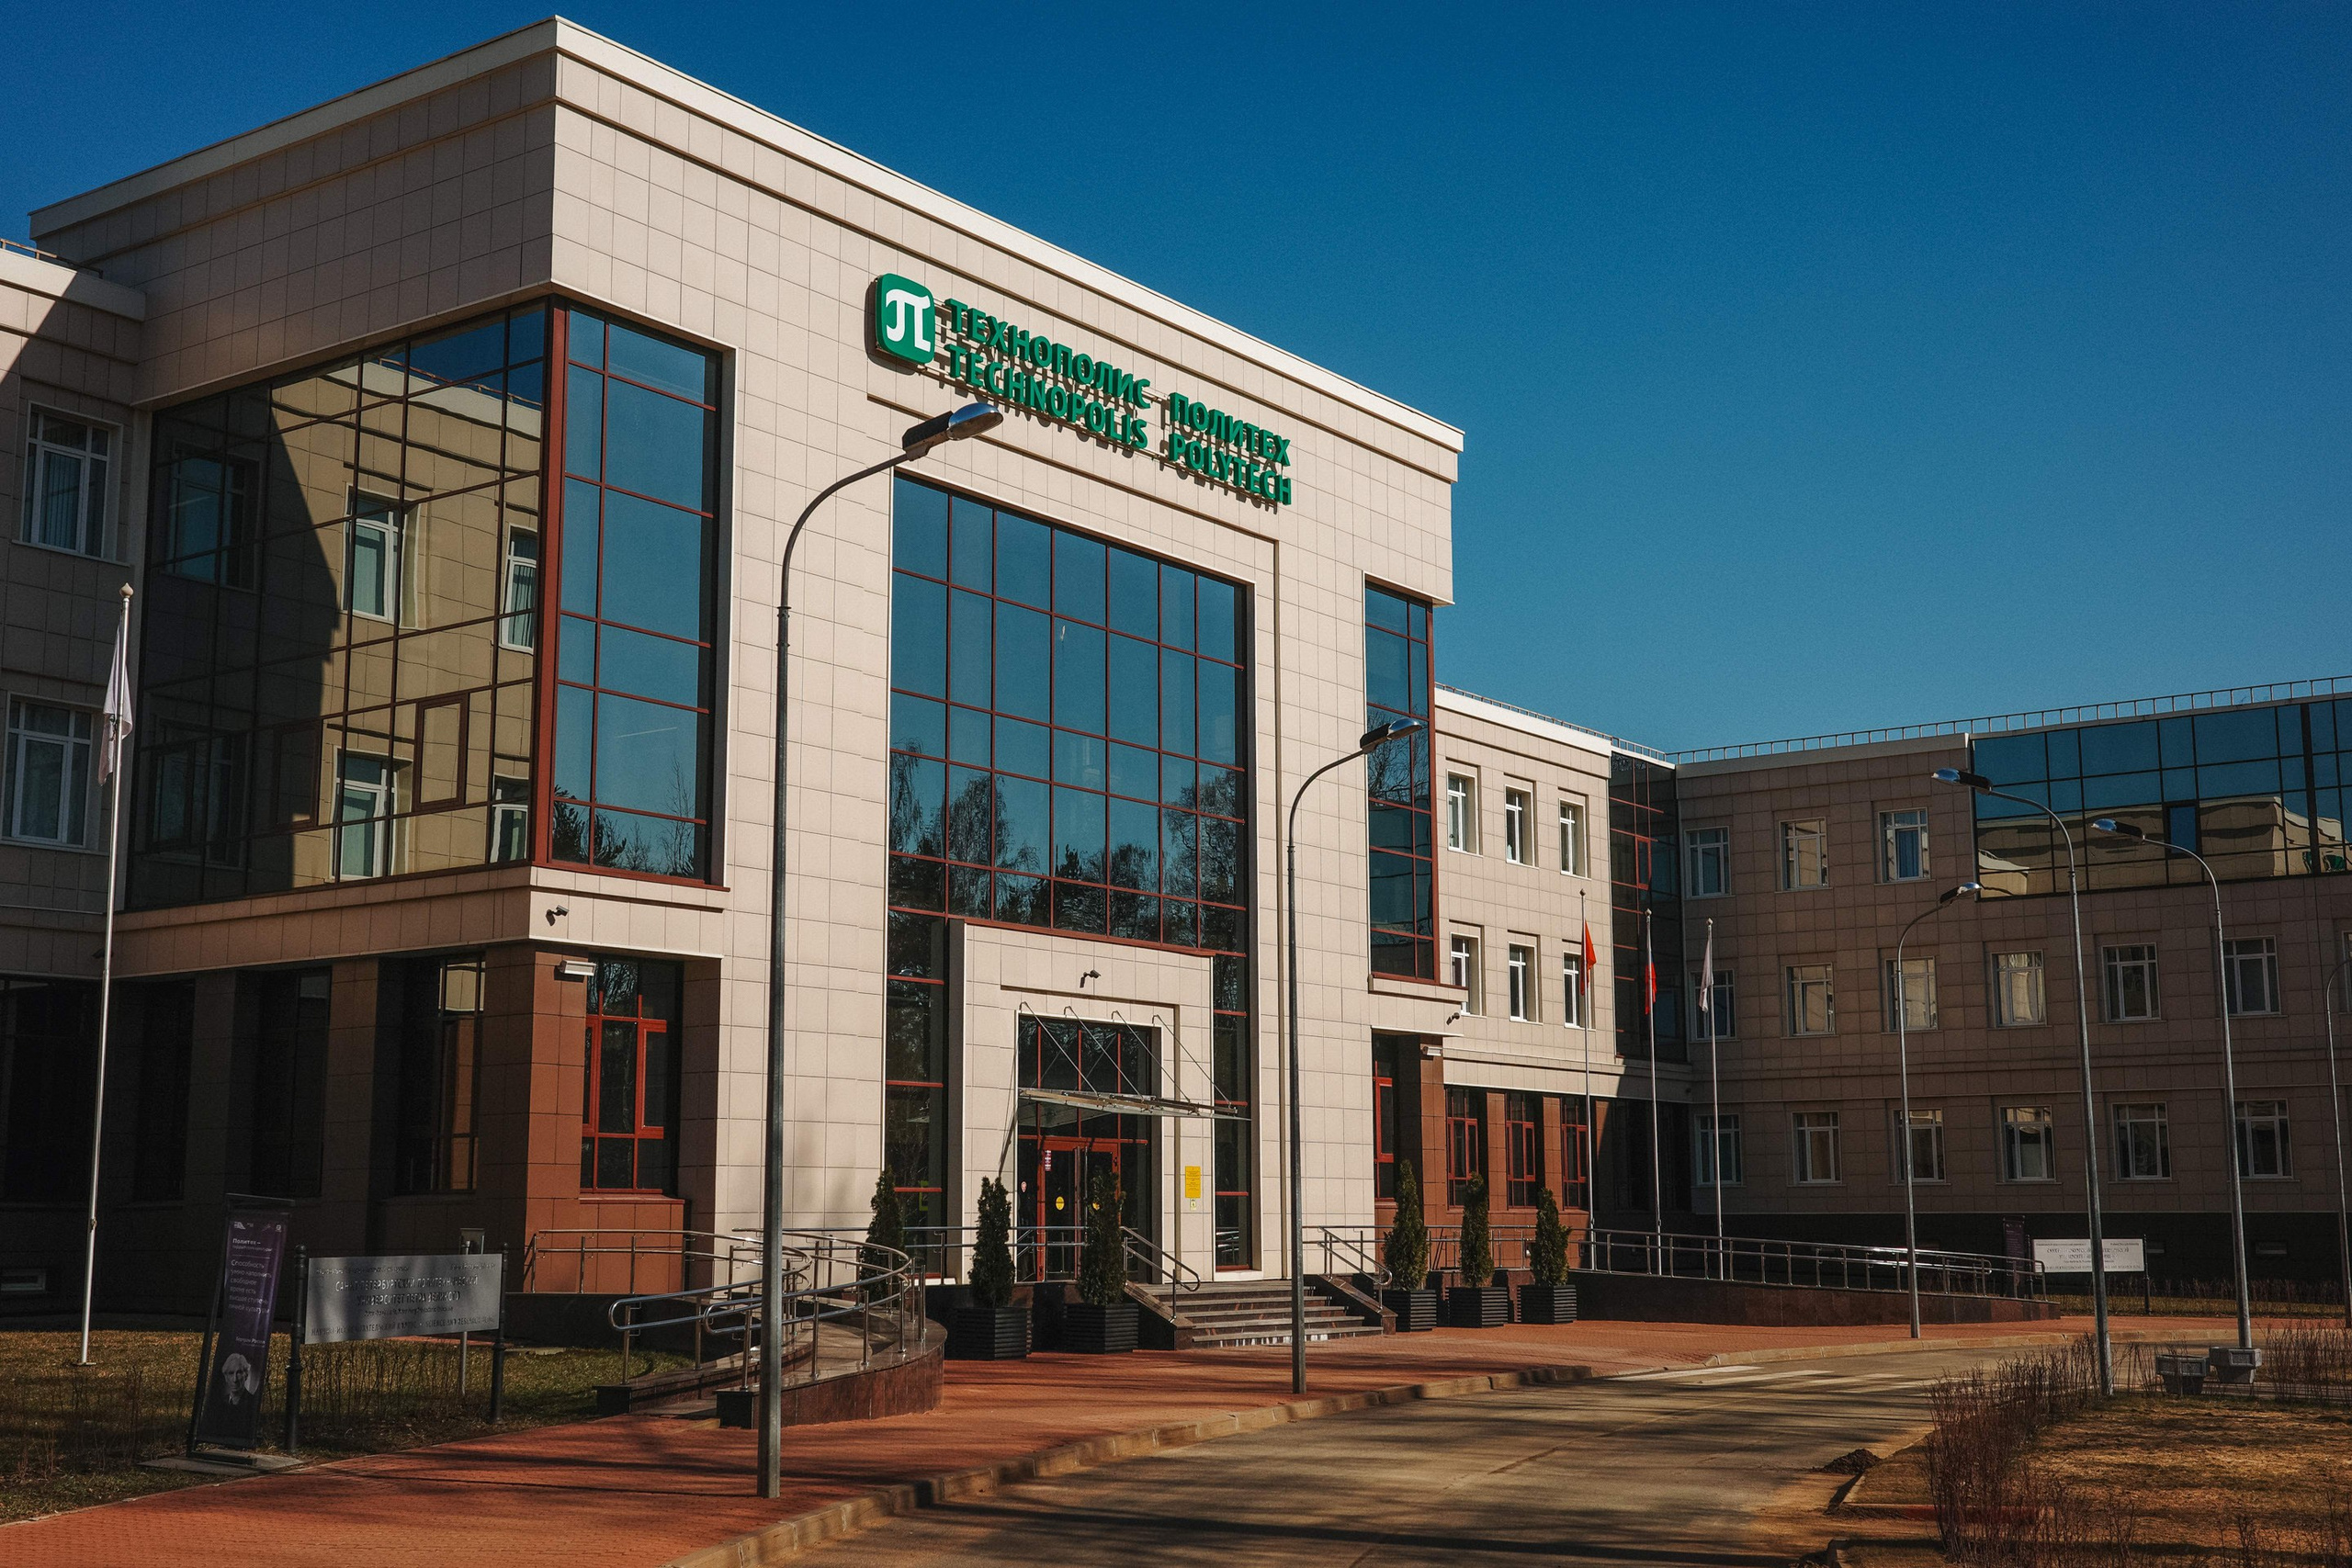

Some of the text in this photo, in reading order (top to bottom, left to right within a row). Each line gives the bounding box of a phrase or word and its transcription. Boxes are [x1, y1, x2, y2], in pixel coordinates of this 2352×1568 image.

[944, 298, 1292, 467] ТЕХНОПОЛИС ПОЛИТЕХ
[944, 344, 1293, 505] TECHNOPOLIS POLYTECH
